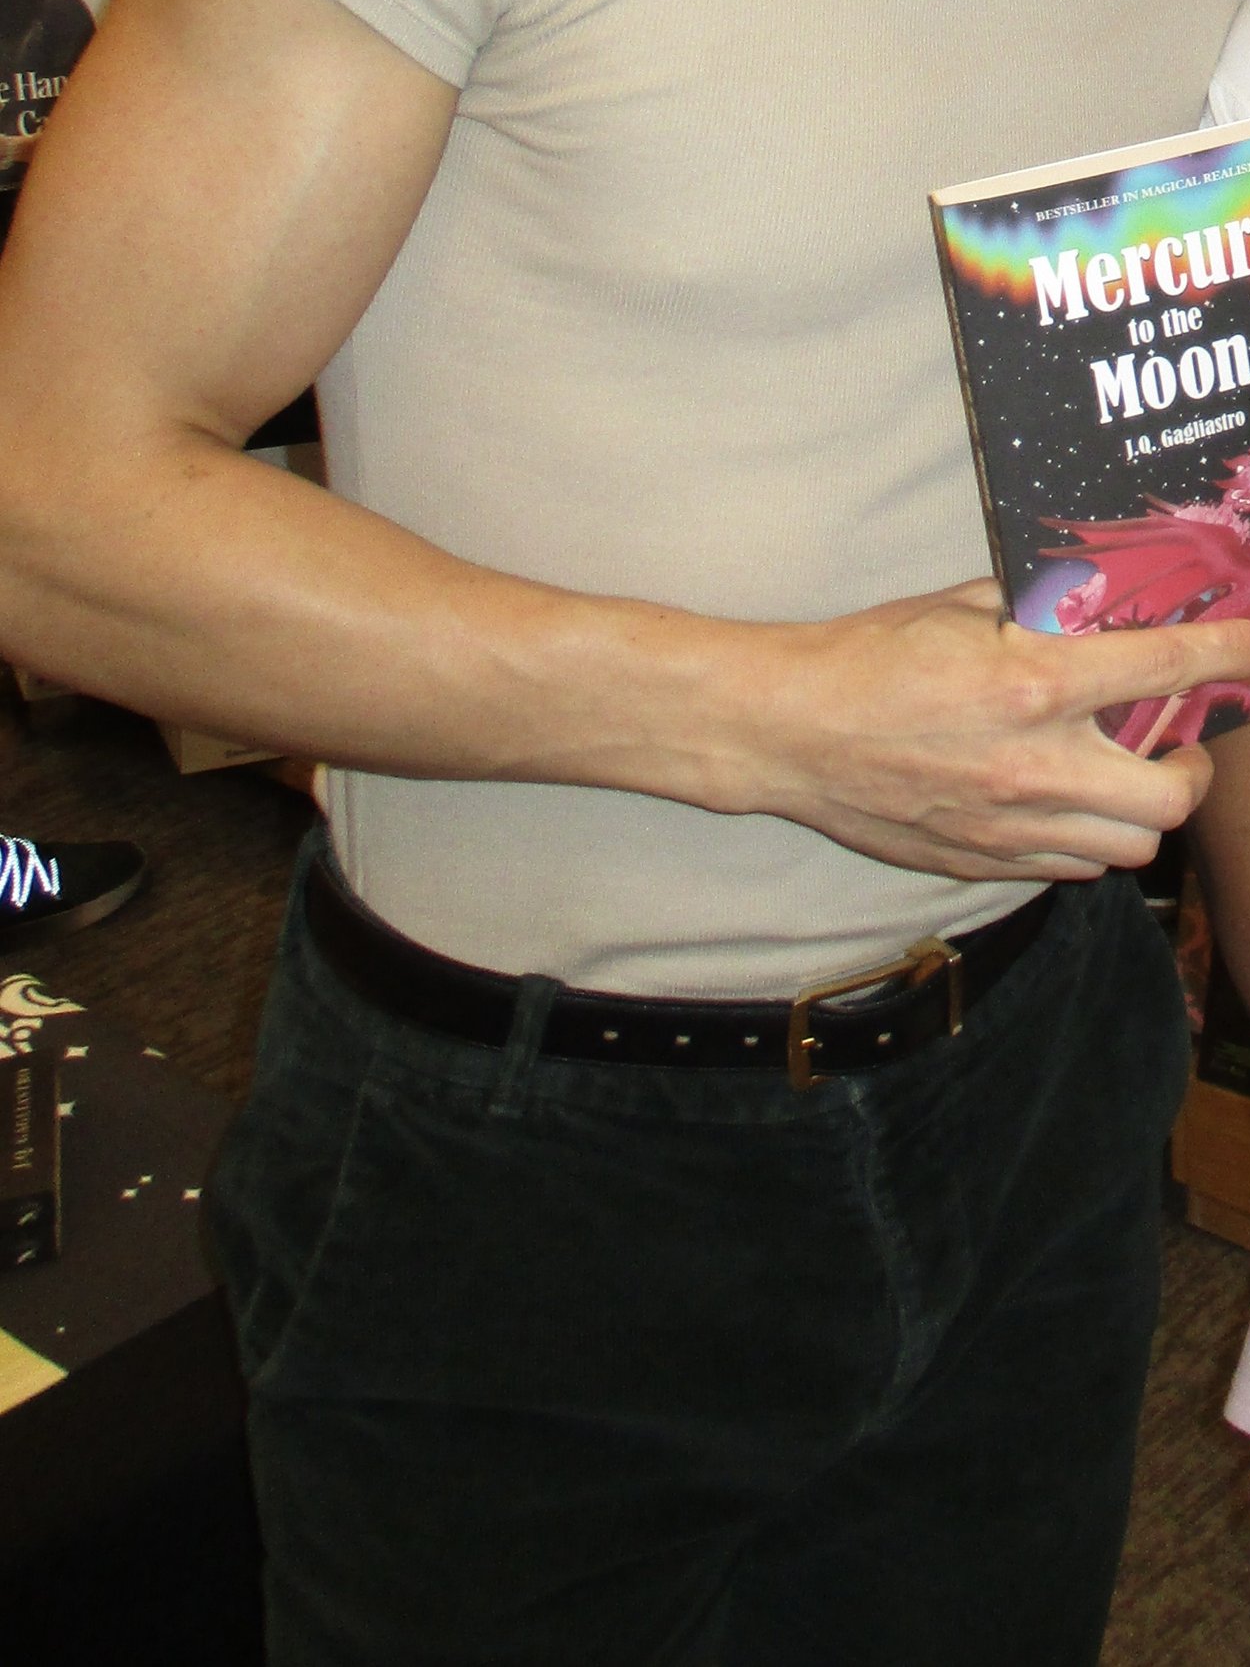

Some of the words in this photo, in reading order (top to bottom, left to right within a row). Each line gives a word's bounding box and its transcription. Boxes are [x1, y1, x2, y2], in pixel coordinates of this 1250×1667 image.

[1035, 194, 1121, 222] BESTSELLER
[1122, 190, 1139, 203] IN
[1141, 175, 1202, 200] MAGICAL
[1127, 318, 1156, 346] to
[1160, 306, 1204, 338] the
[1125, 434, 1157, 462] J.Q.
[1160, 410, 1247, 449] Gagliastro
